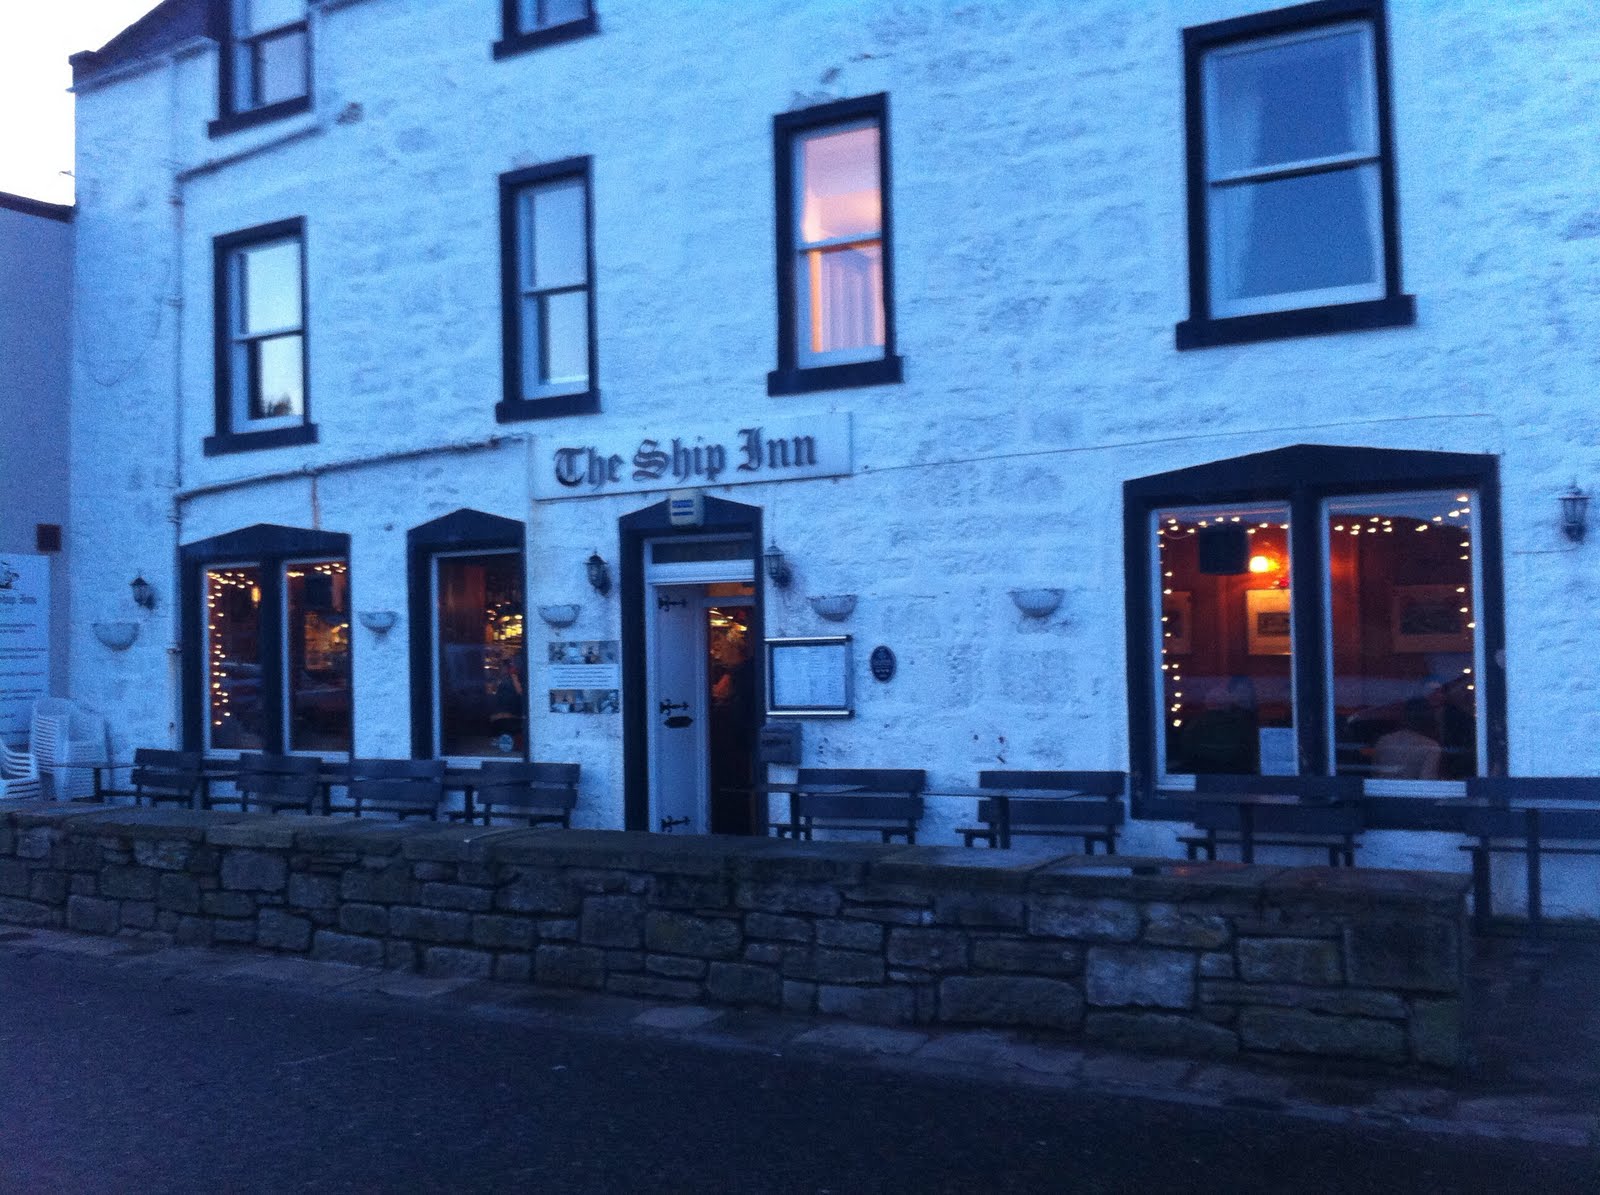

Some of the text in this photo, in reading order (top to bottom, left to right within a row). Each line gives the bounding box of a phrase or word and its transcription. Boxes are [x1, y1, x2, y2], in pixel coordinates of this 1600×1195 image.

[554, 427, 817, 490] The Ship Inn
